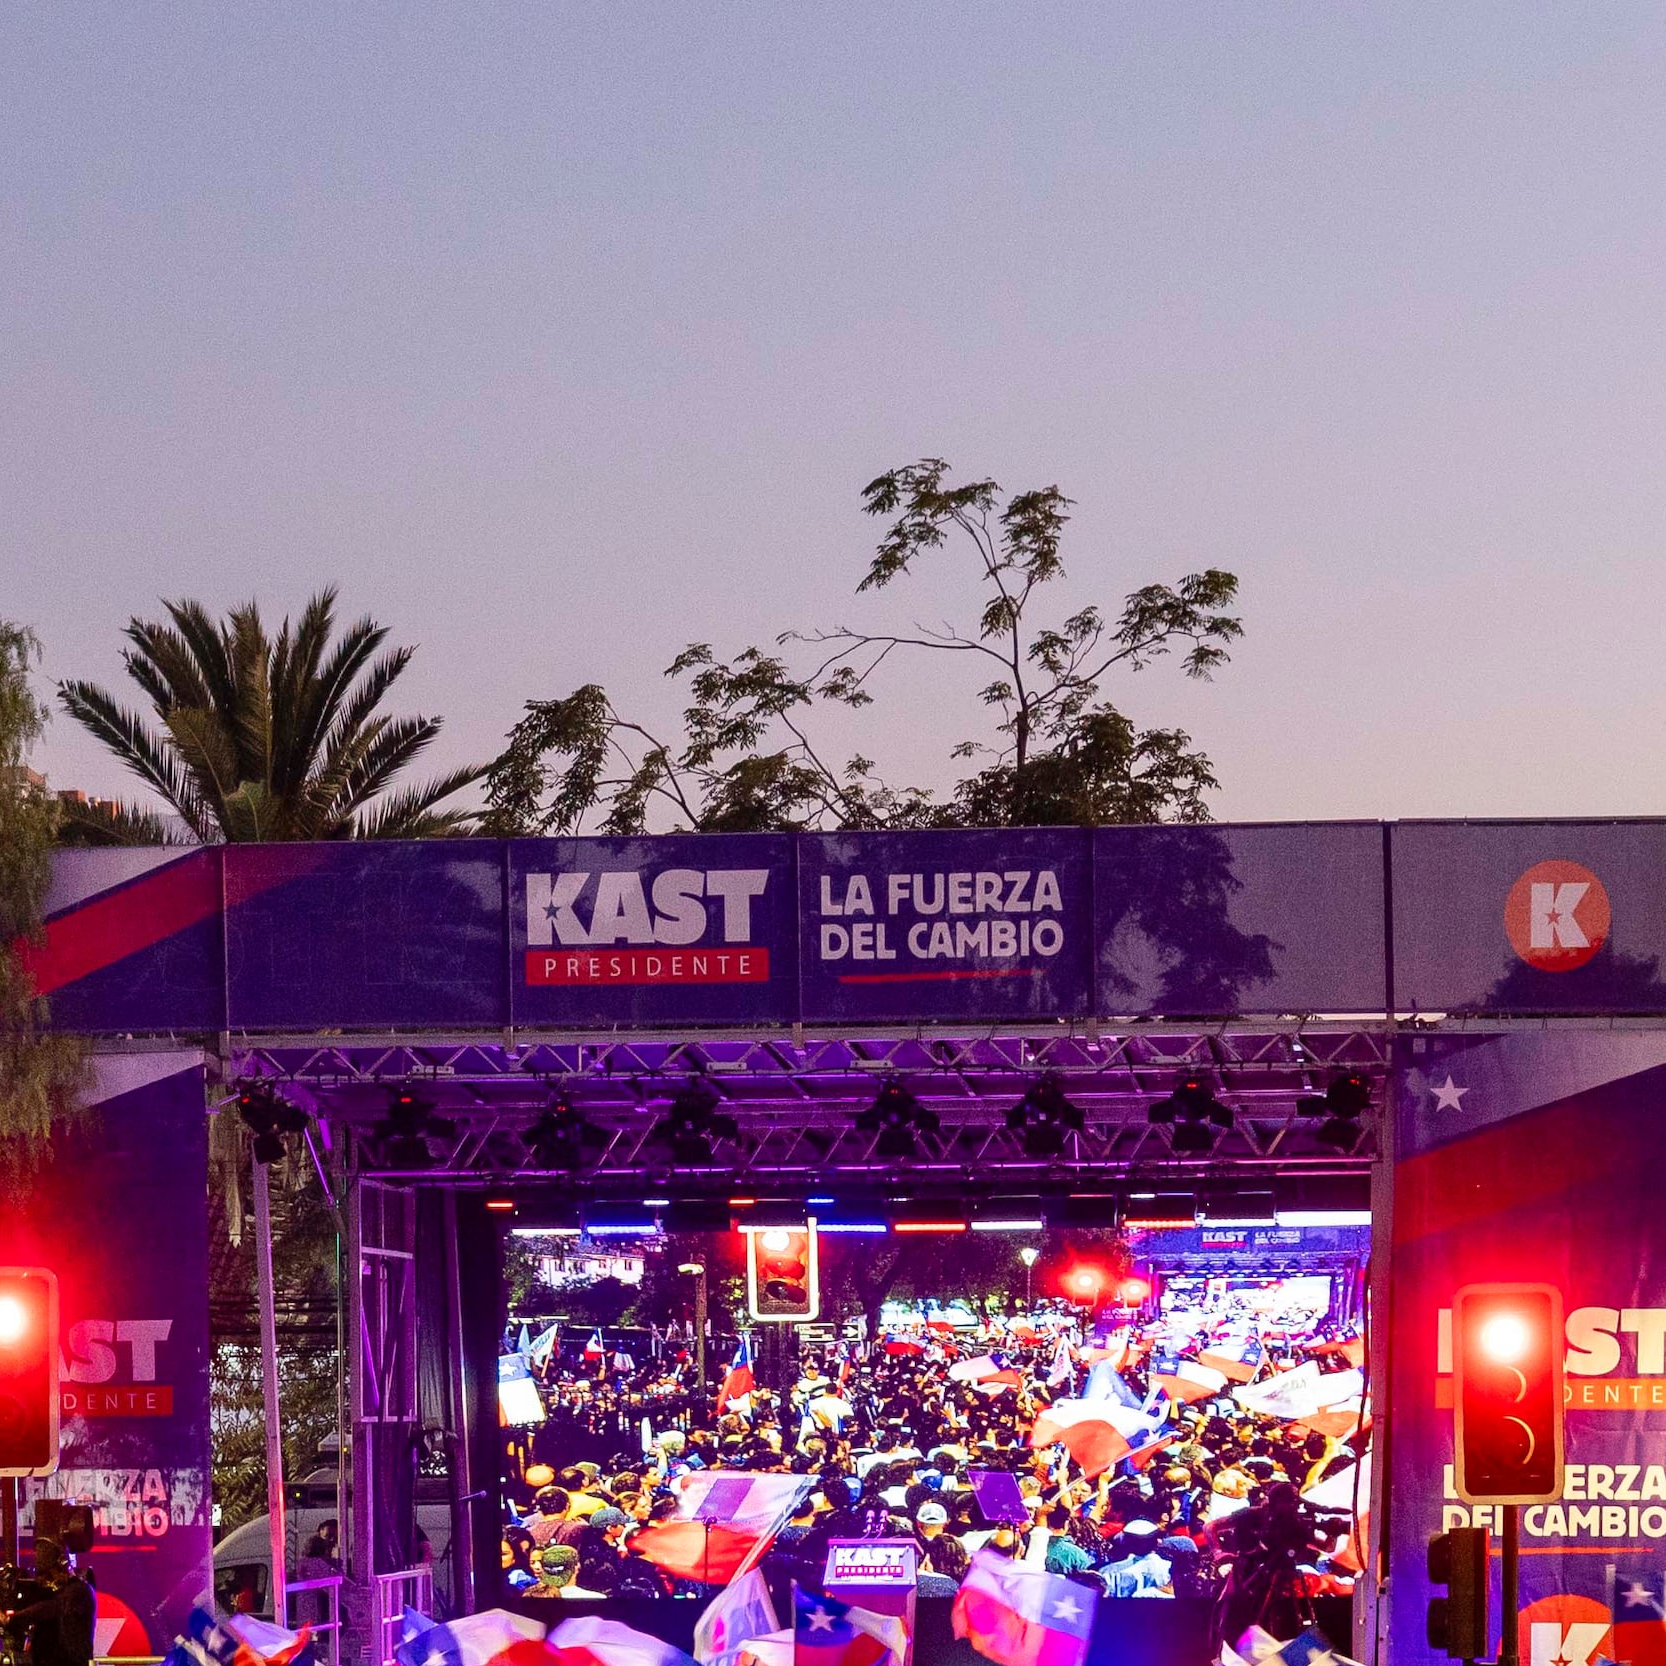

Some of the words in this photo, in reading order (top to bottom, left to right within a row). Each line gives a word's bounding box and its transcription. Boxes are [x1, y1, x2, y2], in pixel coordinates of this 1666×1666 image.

[526, 869, 769, 945] KAST
[820, 874, 874, 916] LA
[887, 870, 1064, 914] FUERZA
[1530, 882, 1590, 948] K
[820, 921, 897, 960] DEL
[907, 919, 1064, 958] CAMBIO
[544, 953, 752, 979] PRESIDENTE
[63, 1392, 157, 1410] DENTE
[835, 1548, 907, 1566] KAST
